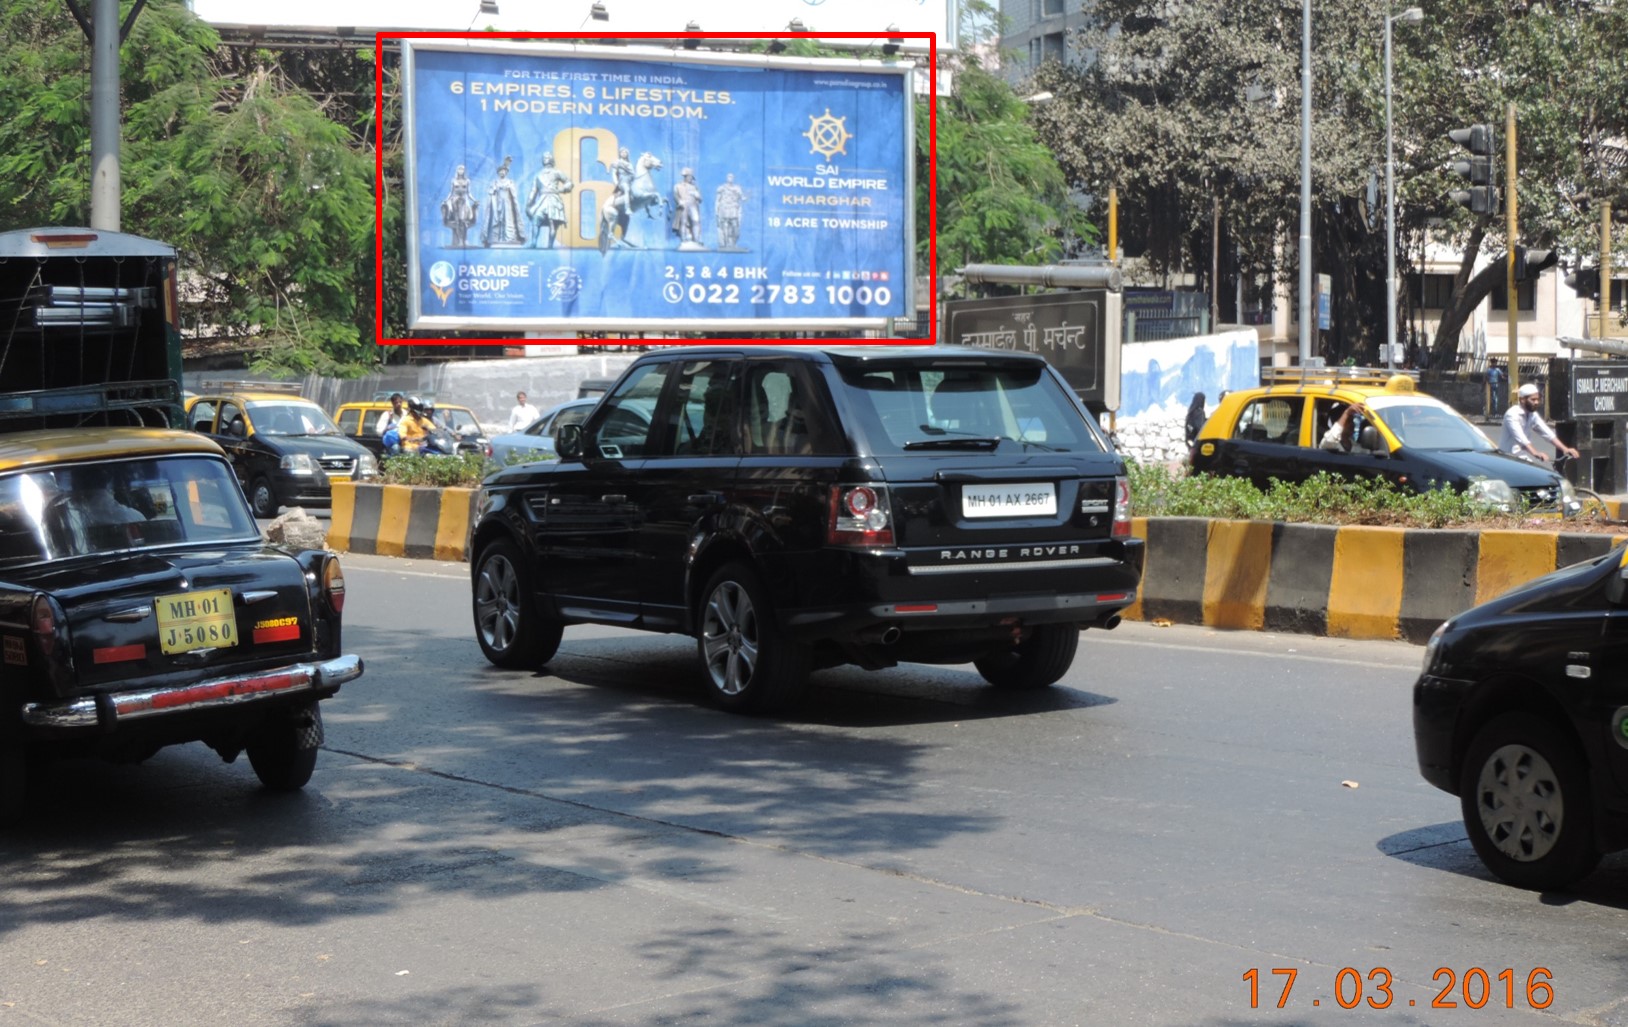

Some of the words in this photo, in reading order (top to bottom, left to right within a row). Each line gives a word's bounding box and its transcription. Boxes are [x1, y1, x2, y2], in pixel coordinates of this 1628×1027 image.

[504, 70, 531, 79] FOR
[533, 71, 558, 80] THE
[562, 72, 598, 81] FIRST
[601, 73, 631, 83] TIME
[634, 75, 647, 84] IN
[650, 76, 687, 85] INDIA.
[450, 81, 464, 94] 6
[470, 82, 577, 99] EMPIRES.
[582, 86, 596, 99] 6
[602, 87, 735, 104] LIFESTYLES.
[480, 99, 488, 112] 1
[494, 99, 593, 115] MODERN
[599, 104, 708, 120] KINGDOM.
[815, 165, 839, 175] SAI
[553, 127, 619, 248] 6
[767, 176, 824, 188] WORLD
[828, 177, 887, 190] EMPIRE
[782, 194, 872, 207] KHARGHAR
[768, 217, 781, 228] 18
[784, 218, 819, 229] ACRE
[822, 218, 888, 231] TOWNSHIP
[458, 265, 529, 277] PARADISE
[664, 266, 680, 281] 2,
[685, 266, 695, 279] 3
[701, 266, 712, 279] &
[717, 266, 728, 279] 4
[733, 267, 768, 280] BHK
[458, 279, 510, 291] GROUP
[688, 284, 740, 304] 022
[750, 285, 816, 305] 2783
[825, 285, 891, 306] 1000
[1043, 321, 1087, 350] मर्चन्ट
[1576, 378, 1594, 394] ISMAIL
[1600, 378, 1628, 393] MERCHANT
[1594, 396, 1615, 411] CHOWK
[967, 495, 986, 508] MH
[989, 494, 1001, 507] 01
[1005, 493, 1022, 506] AX
[1025, 492, 1050, 506] 2667
[940, 550, 1008, 560] RANGE
[1020, 545, 1080, 557] ROVER
[171, 599, 196, 618] MH
[203, 597, 219, 615] 01
[167, 629, 175, 647] J
[184, 623, 231, 645] 5080
